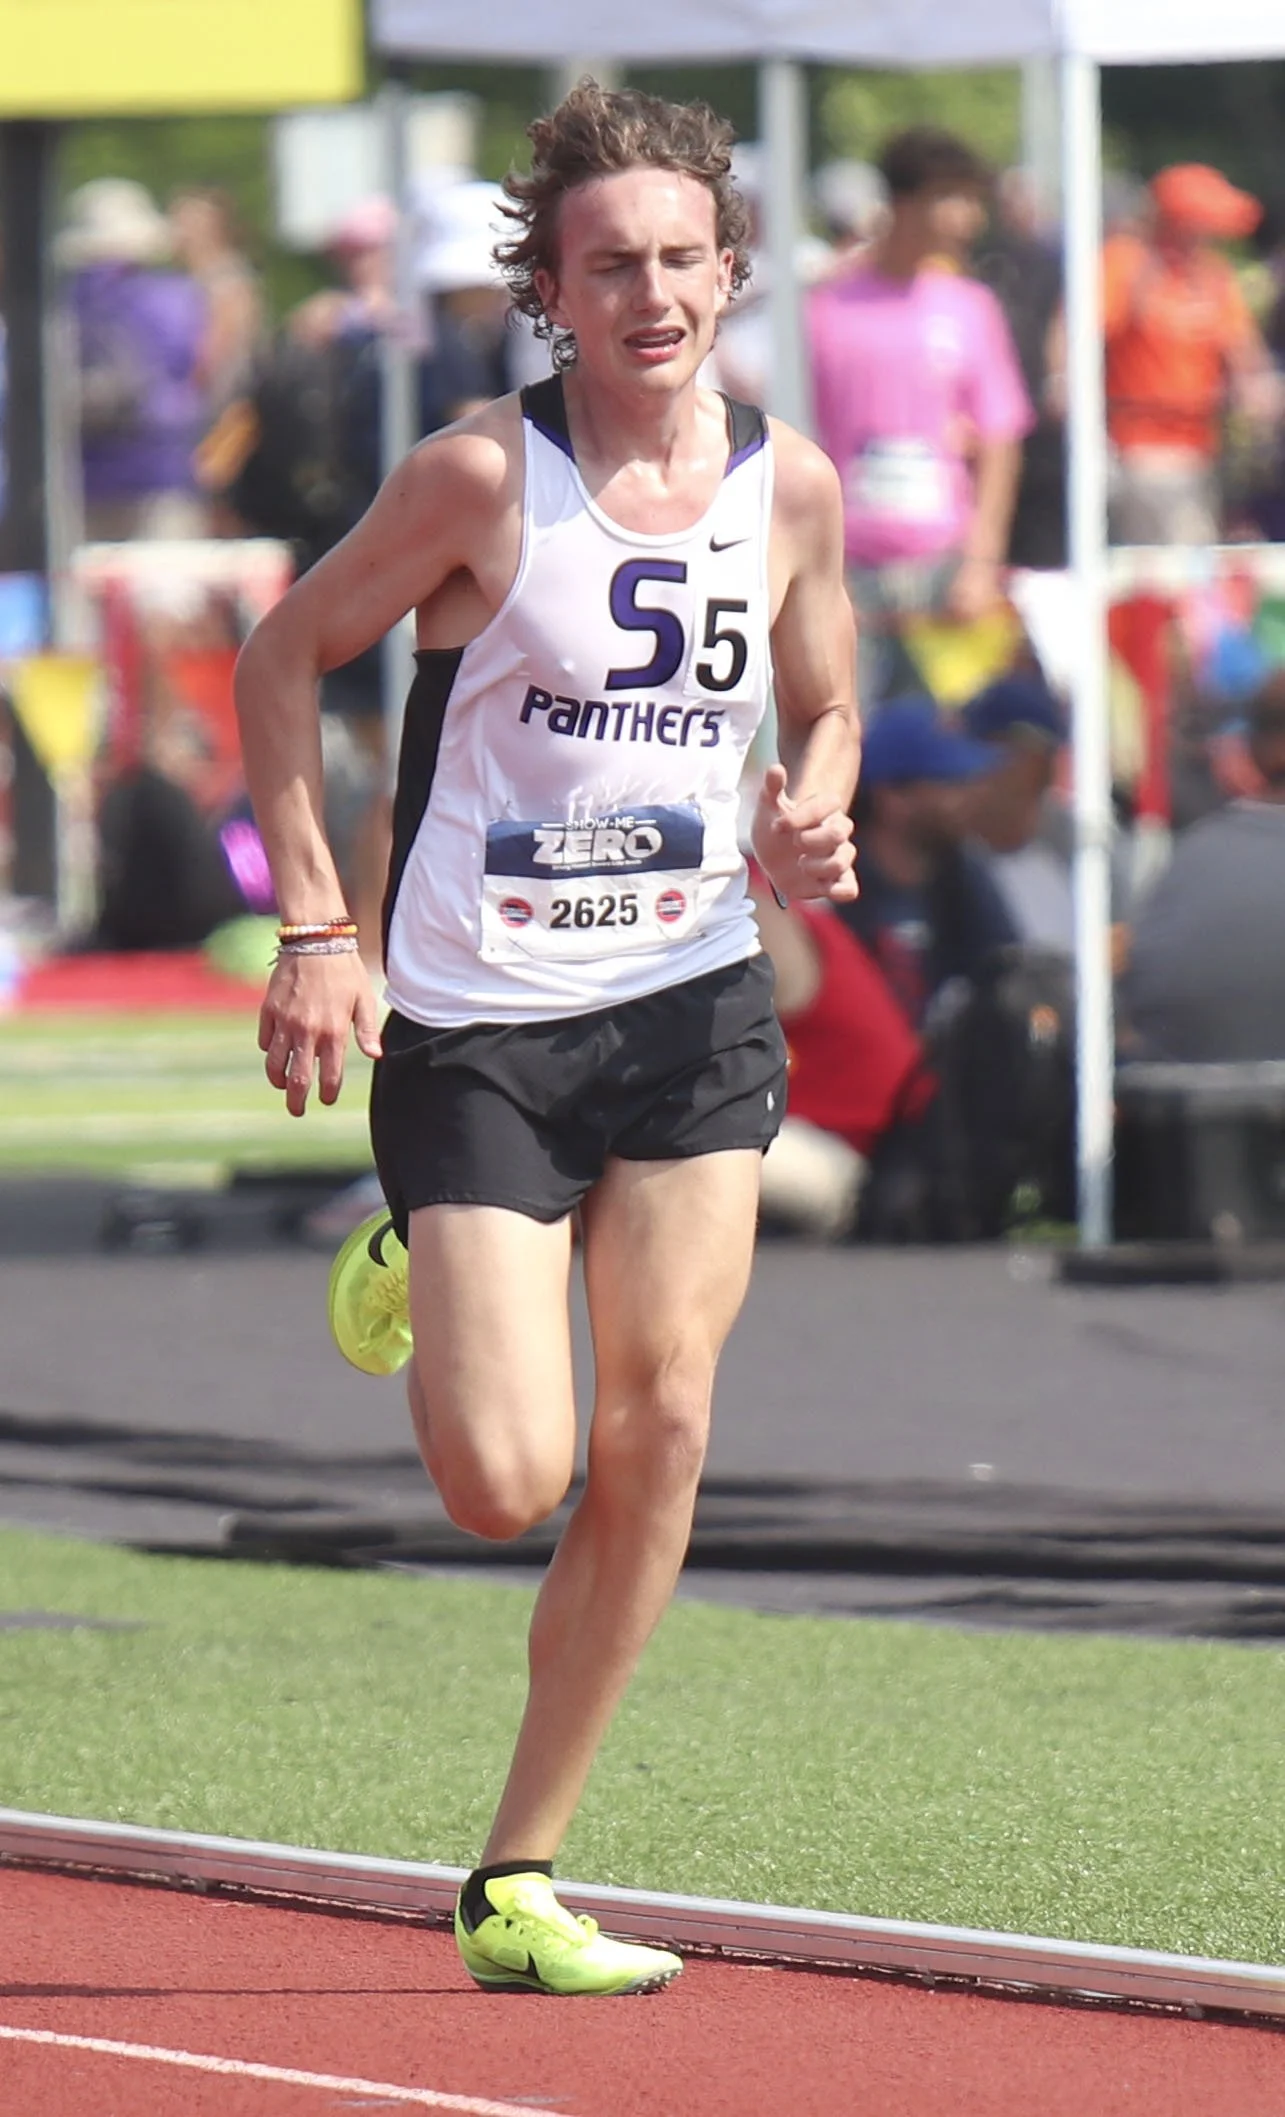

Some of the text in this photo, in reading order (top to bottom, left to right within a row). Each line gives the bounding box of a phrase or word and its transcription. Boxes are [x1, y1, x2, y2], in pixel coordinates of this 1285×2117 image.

[605, 557, 688, 691] S
[695, 597, 748, 692] 5
[532, 826, 663, 864] ZERO
[550, 893, 639, 929] 2625
